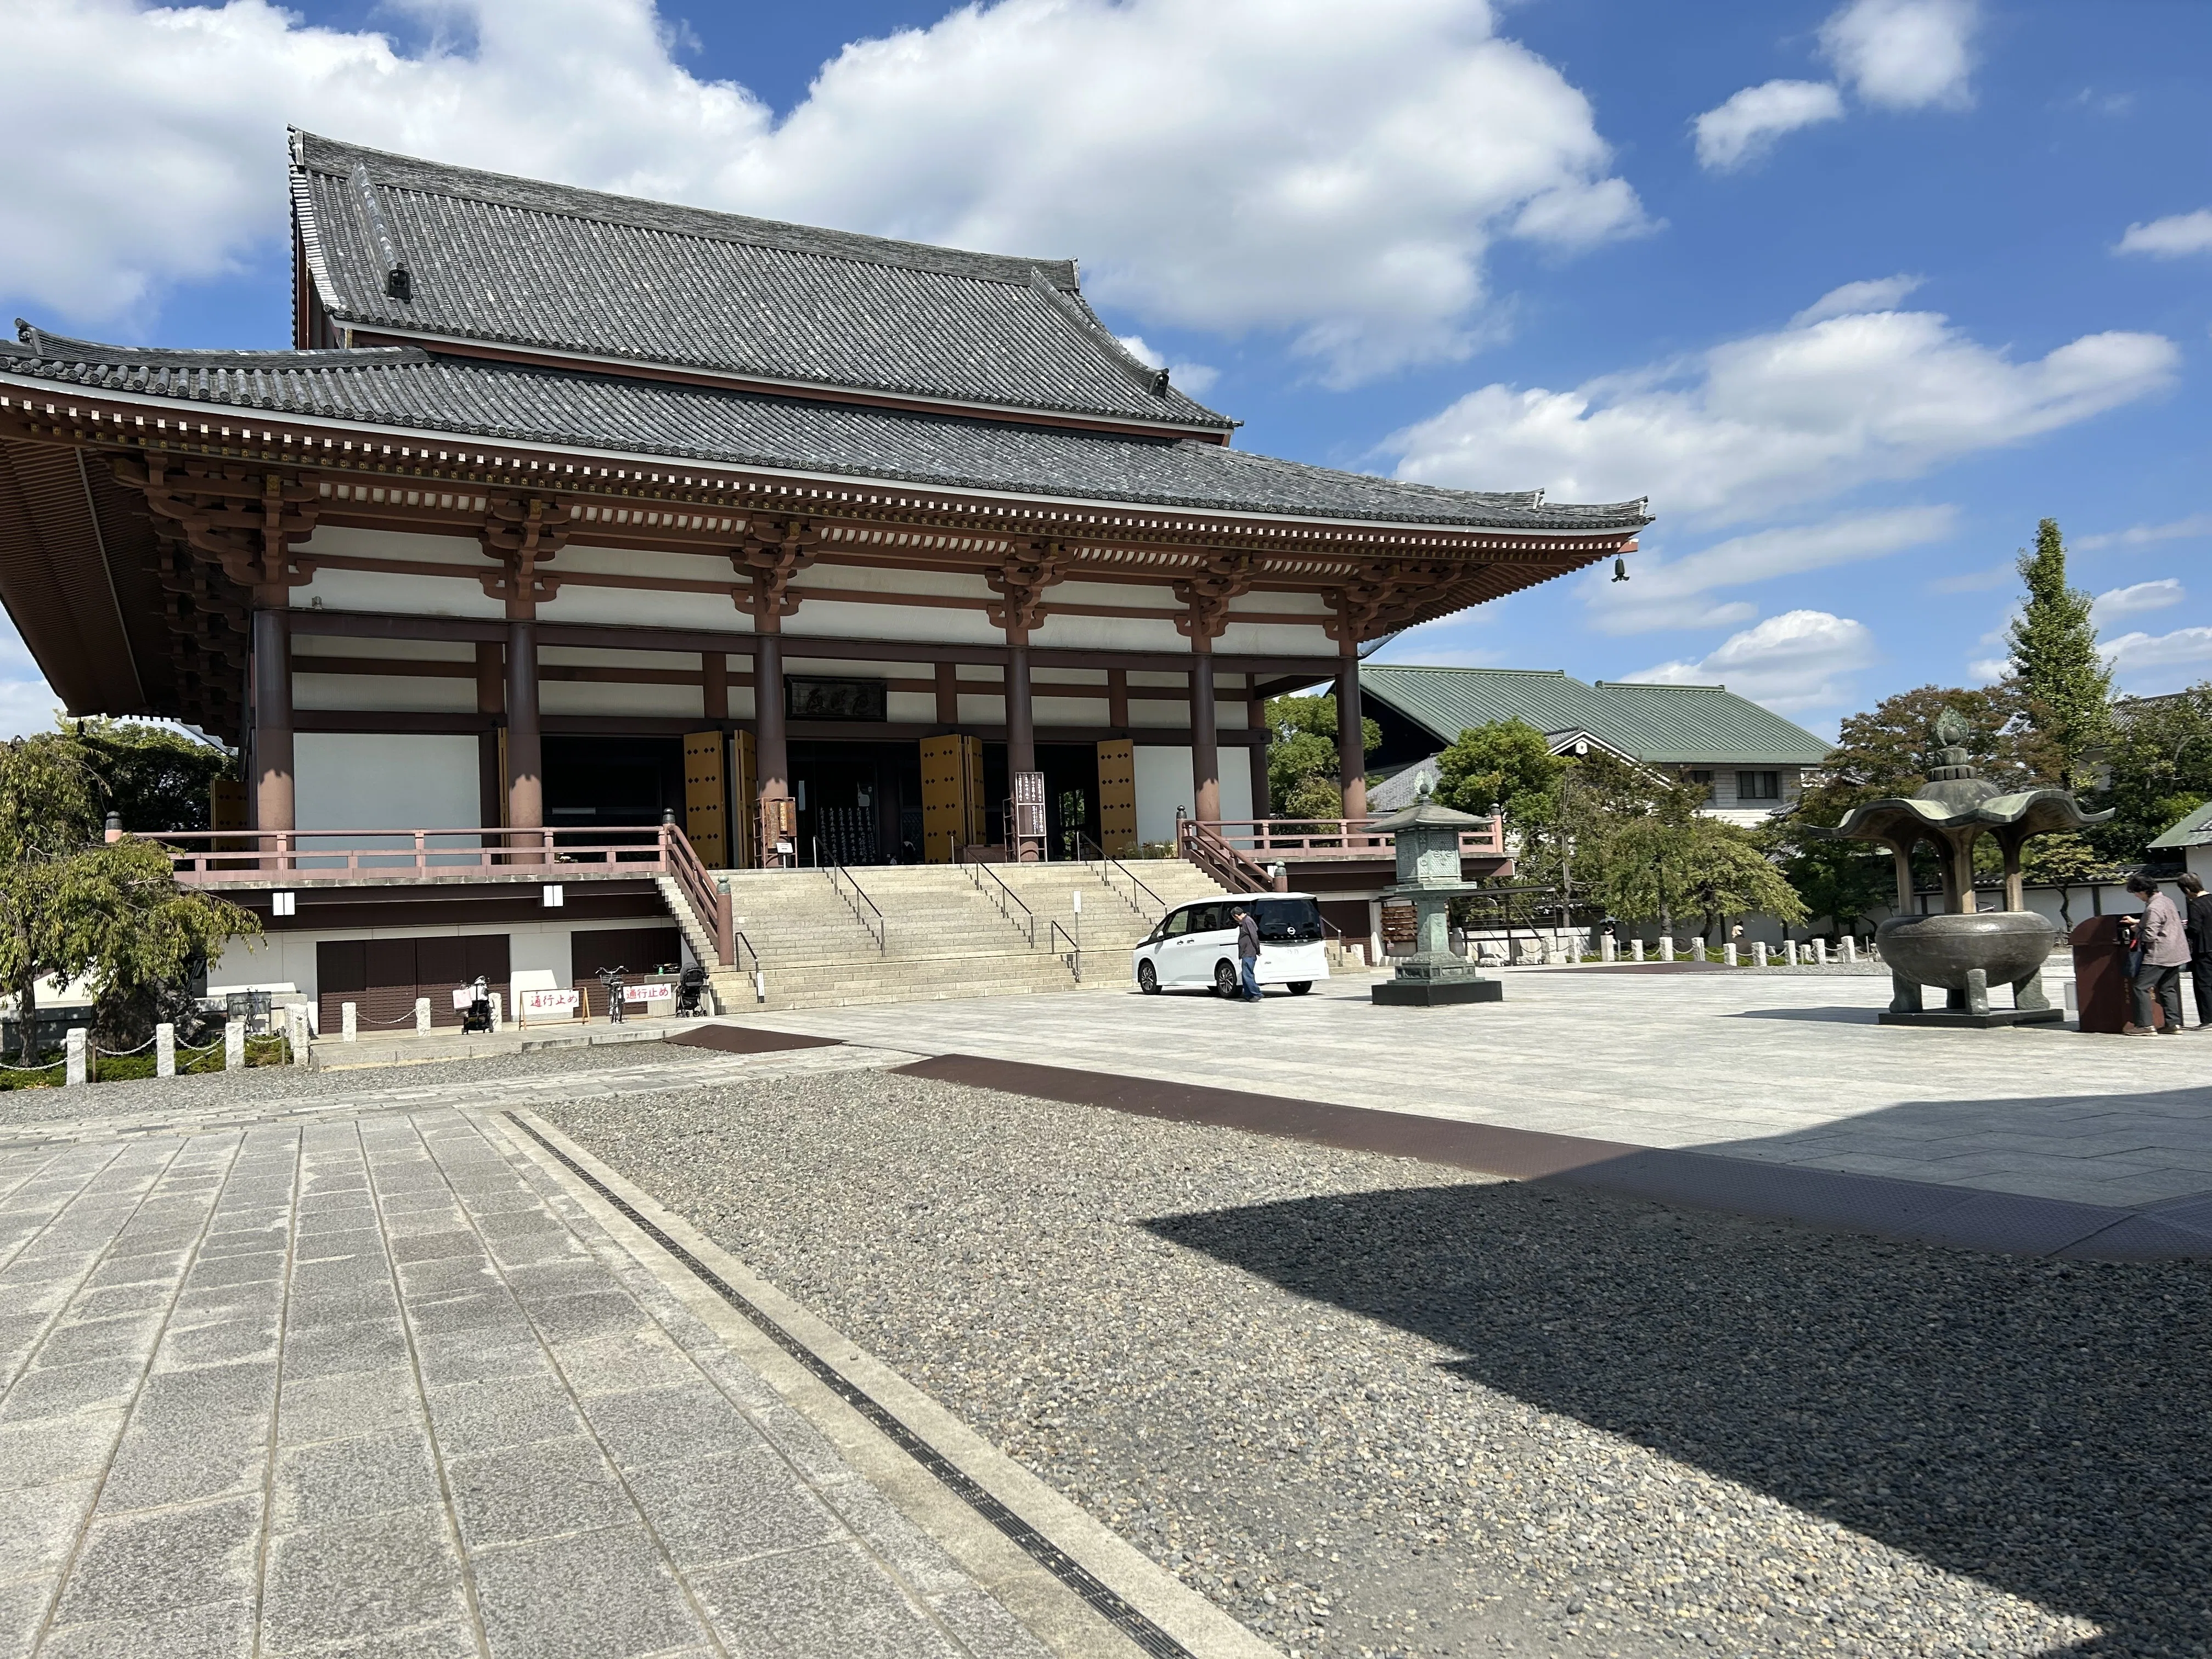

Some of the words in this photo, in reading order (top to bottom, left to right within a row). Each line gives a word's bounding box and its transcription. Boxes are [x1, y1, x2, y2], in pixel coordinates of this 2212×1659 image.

[626, 987, 669, 999] 通行止め
[530, 994, 578, 1007] 通行止め
